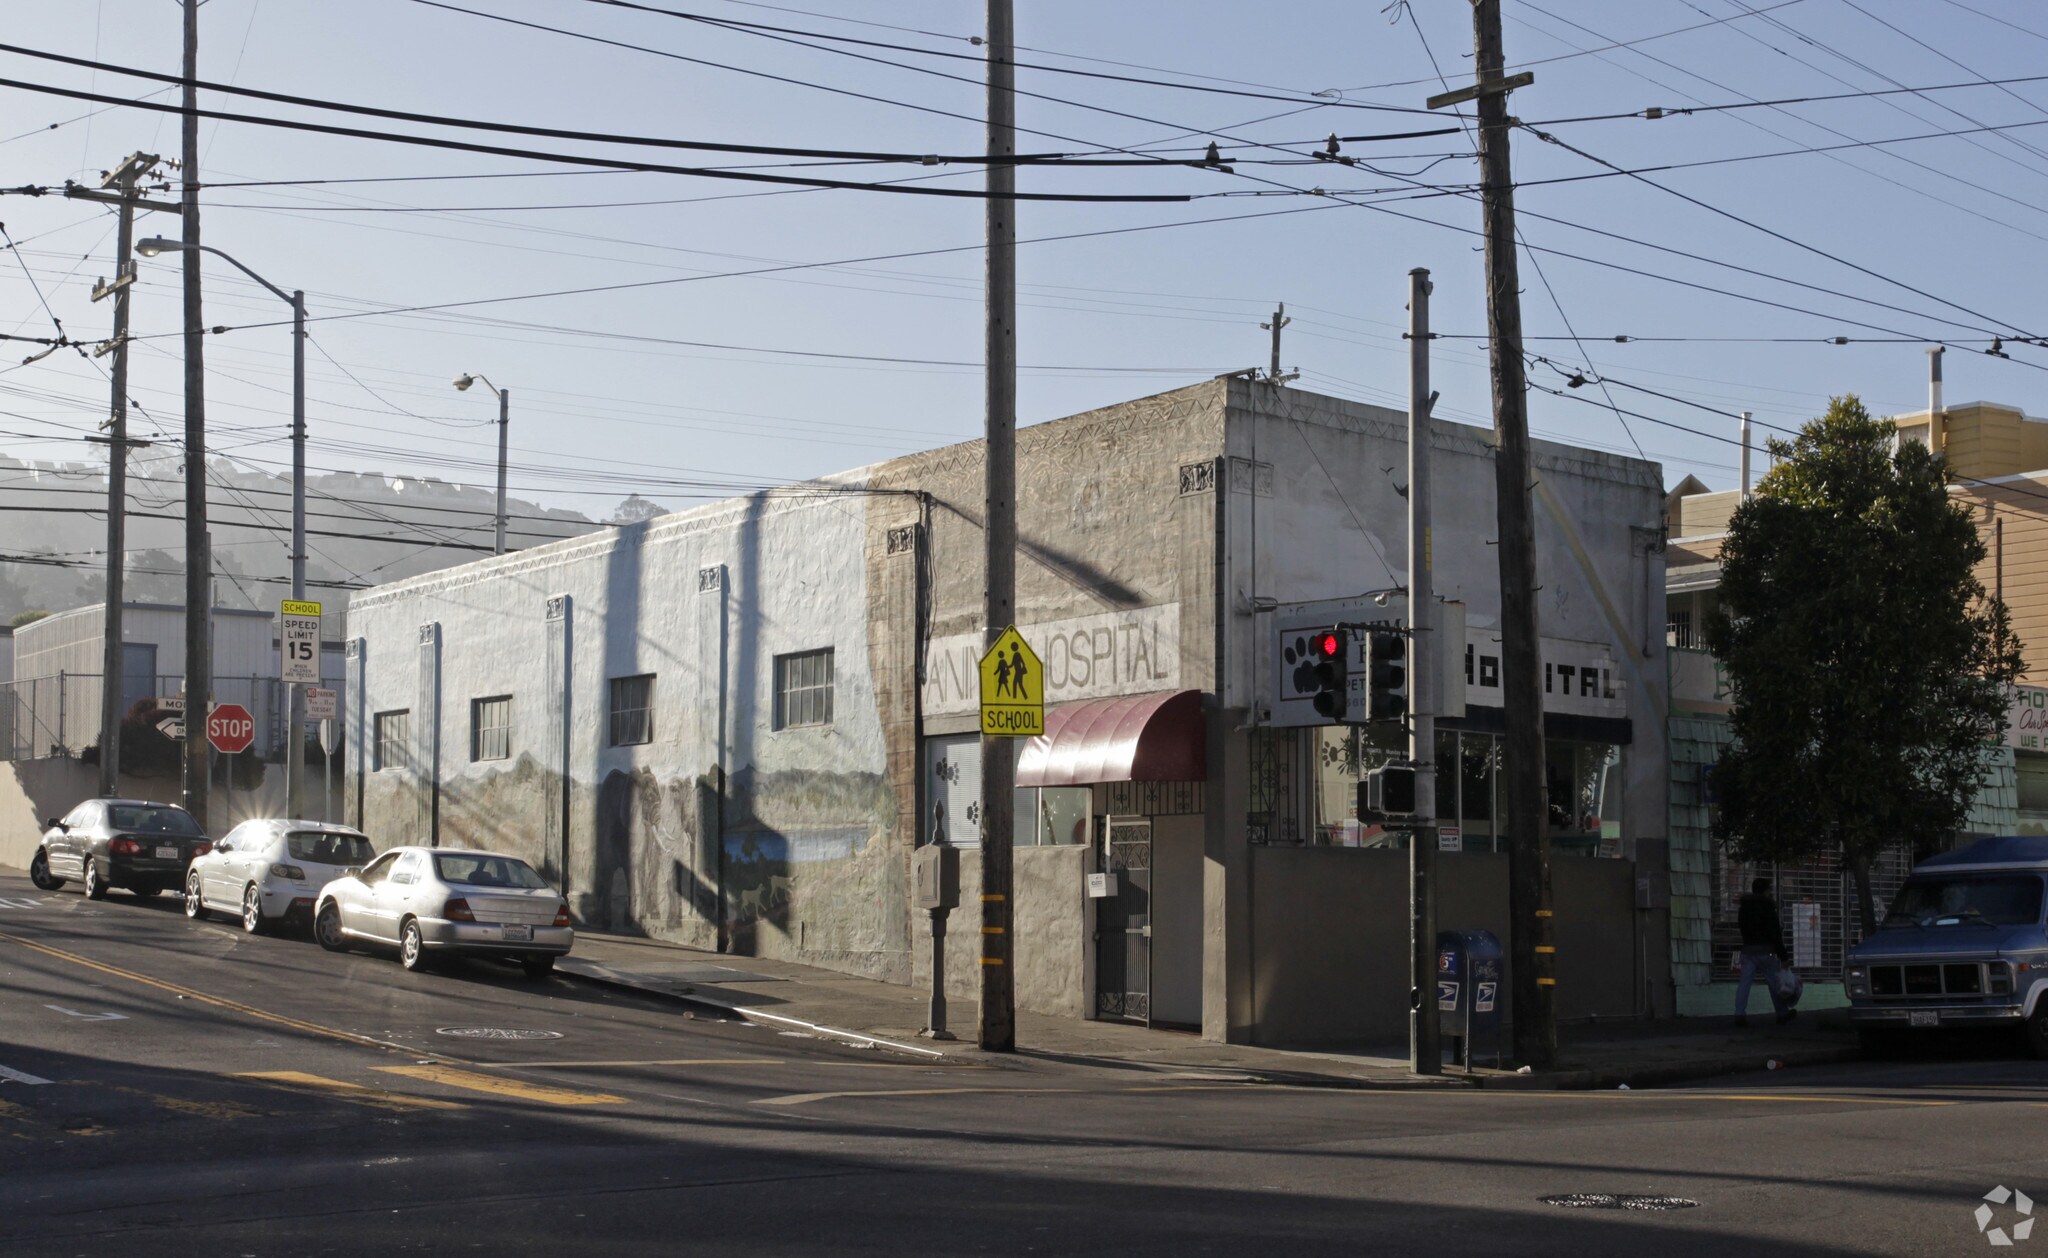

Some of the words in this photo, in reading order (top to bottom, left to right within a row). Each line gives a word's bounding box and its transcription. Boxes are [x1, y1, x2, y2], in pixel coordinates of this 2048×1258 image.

[284, 603, 318, 614] SCHOOL
[285, 620, 317, 630] SPEED
[288, 631, 314, 640] LIMIT
[288, 641, 313, 660] 15
[1028, 620, 1169, 691] HOSPITAL
[308, 689, 316, 697] NO
[317, 690, 336, 698] PARKING
[2019, 690, 2048, 709] HO
[165, 701, 186, 709] MO
[987, 711, 1039, 730] SCHOOL
[176, 727, 186, 735] ON
[210, 719, 252, 737] STOP
[2020, 735, 2038, 748] WE
